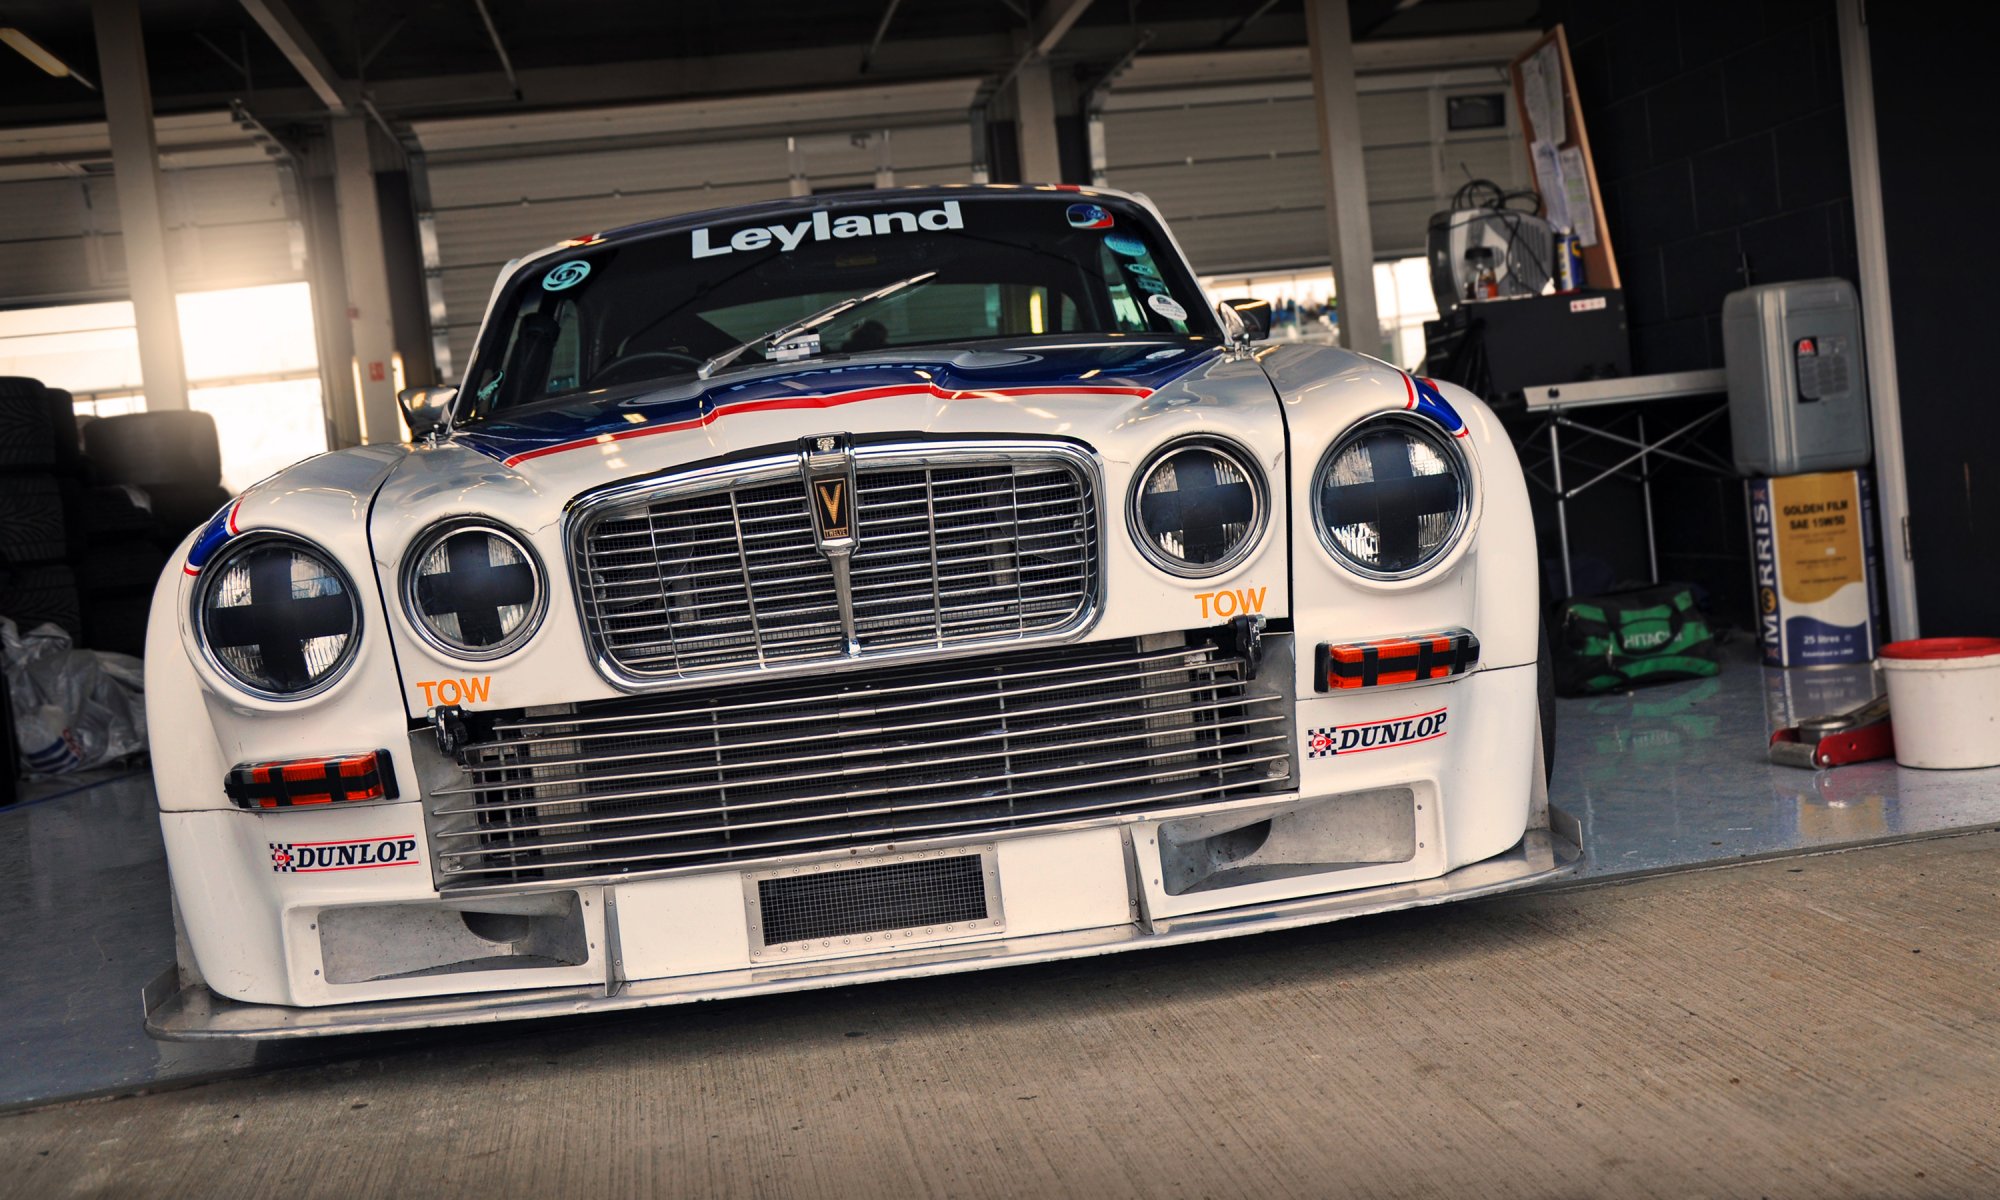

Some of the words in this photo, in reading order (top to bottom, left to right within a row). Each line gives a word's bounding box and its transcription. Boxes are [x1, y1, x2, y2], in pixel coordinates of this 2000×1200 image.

[691, 200, 965, 260] Leyland
[819, 483, 842, 525] V
[1783, 503, 1825, 517] GOLDEN
[1826, 500, 1849, 513] FILM
[825, 528, 848, 538] TWELVE
[1790, 518, 1809, 530] SAE
[1194, 586, 1267, 618] TOW
[1803, 635, 1816, 645] 25
[416, 675, 491, 706] TOW
[1338, 712, 1447, 750] DUNLOP
[296, 840, 416, 868] DUNLOP
